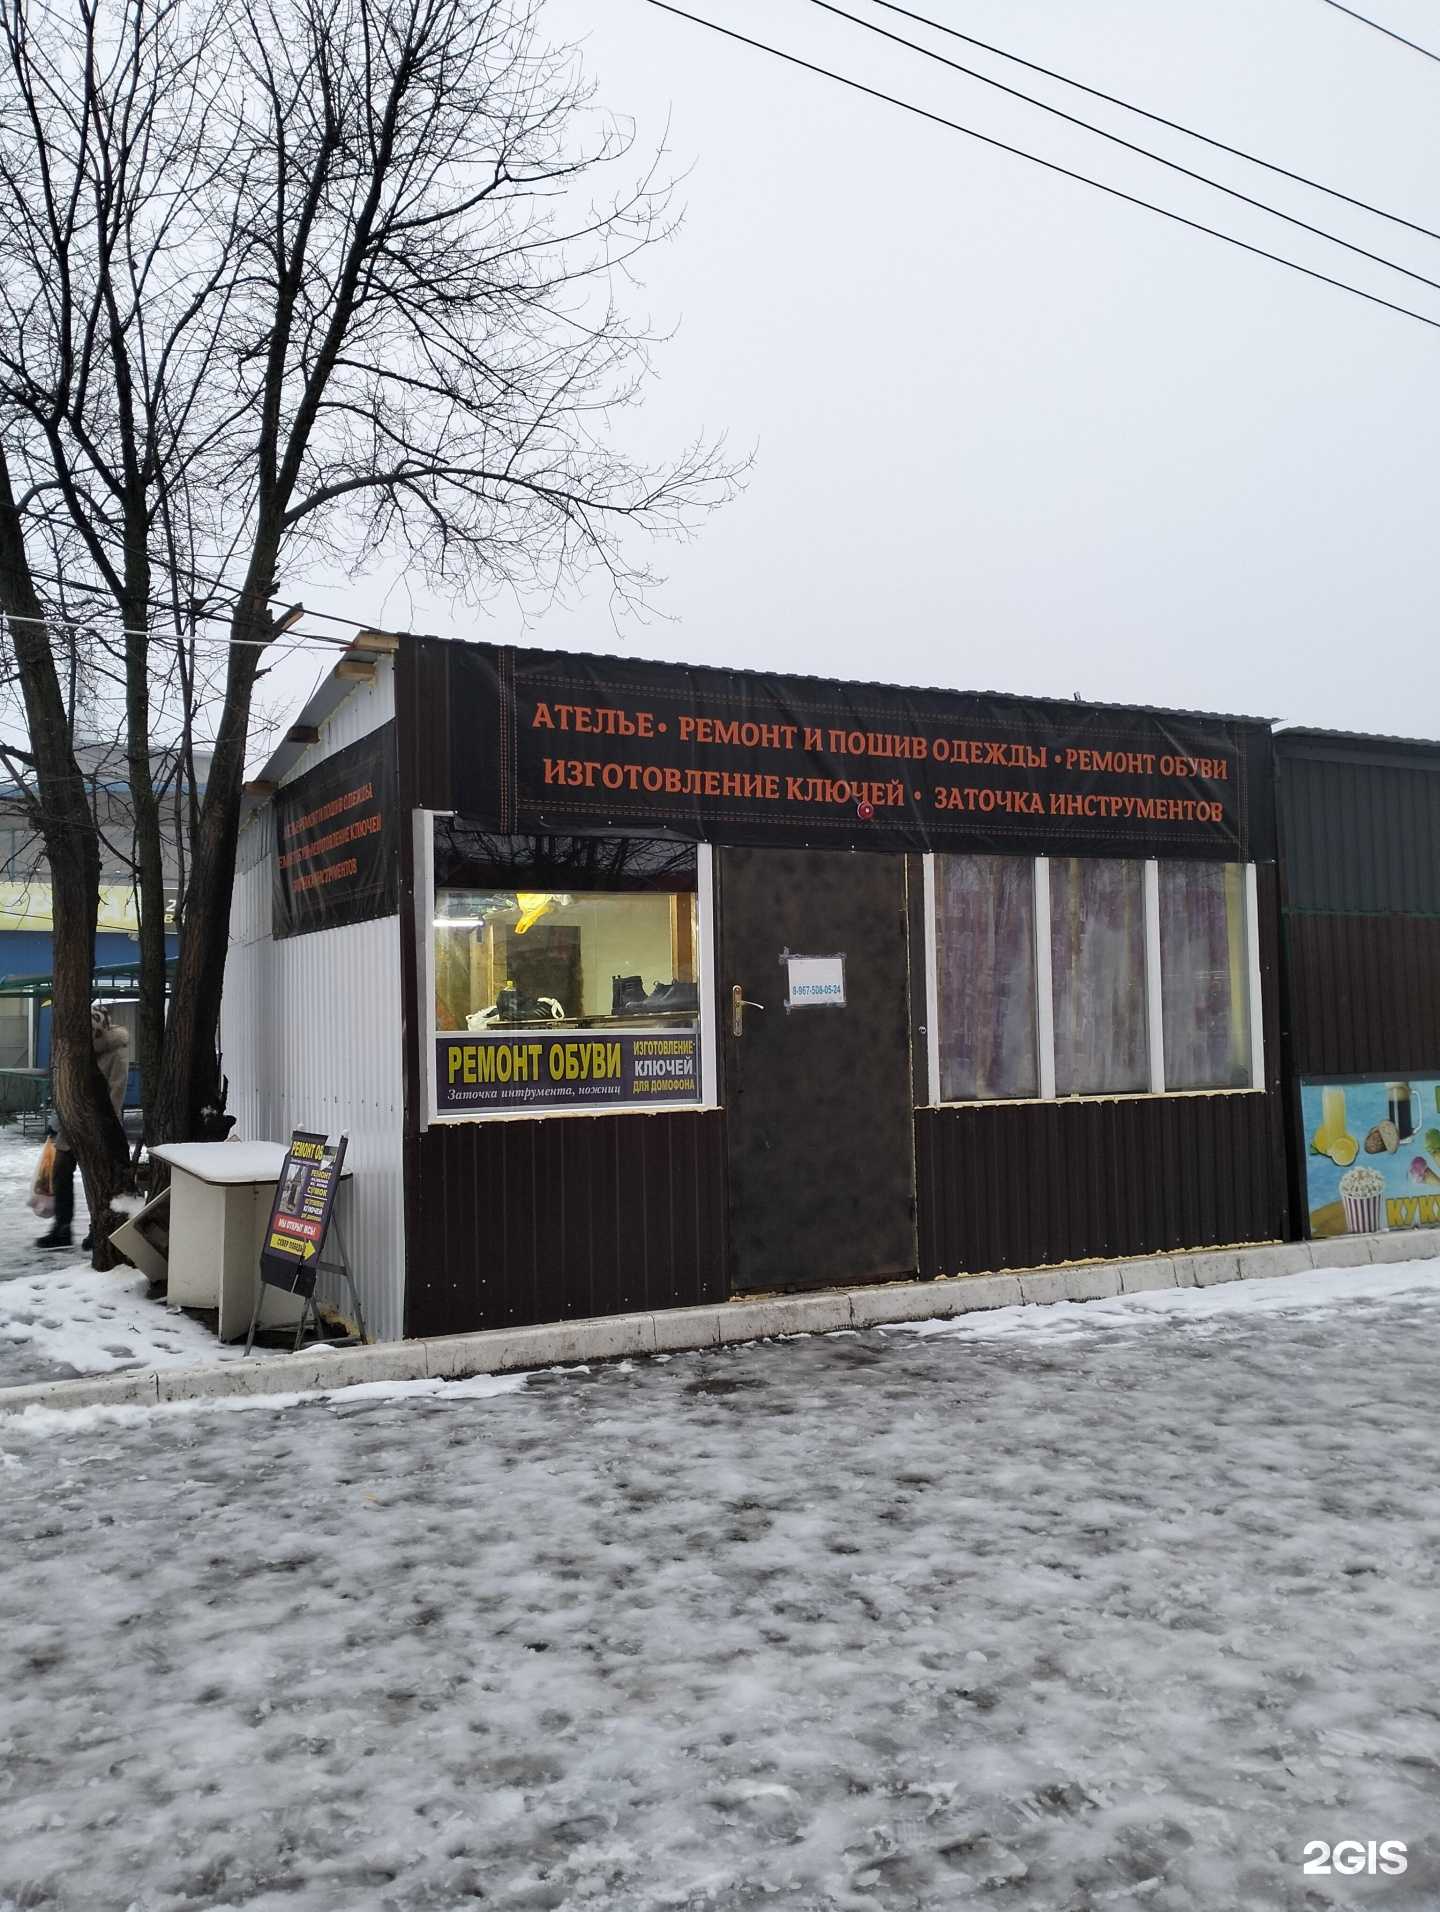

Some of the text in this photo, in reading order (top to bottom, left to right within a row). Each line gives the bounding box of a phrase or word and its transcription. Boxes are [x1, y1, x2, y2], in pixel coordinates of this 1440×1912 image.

[679, 716, 797, 749] РЕМОНТ
[804, 727, 823, 752] И
[829, 729, 928, 759] ПОШИВ
[932, 739, 1047, 769] ОДЕЖДЫ
[1066, 749, 1155, 774] РЕМОНТ
[1159, 756, 1227, 780] ОБУВИ
[543, 758, 1223, 823] ИЗГОТОВЛЕНИЕ КЛЮЧЕЙ ЗАТОЧКА ИНСТРУМЕНТОВ
[448, 1042, 621, 1084] РЕМОНТ ОБУВИ
[634, 1055, 693, 1076] КЛЮЧЕЙ
[447, 1088, 498, 1100] Заточка
[578, 1085, 621, 1097] ножниц
[632, 1078, 695, 1094] ДЛЯ ДОМОФОНА
[292, 1141, 316, 1158] РЕМОНТ
